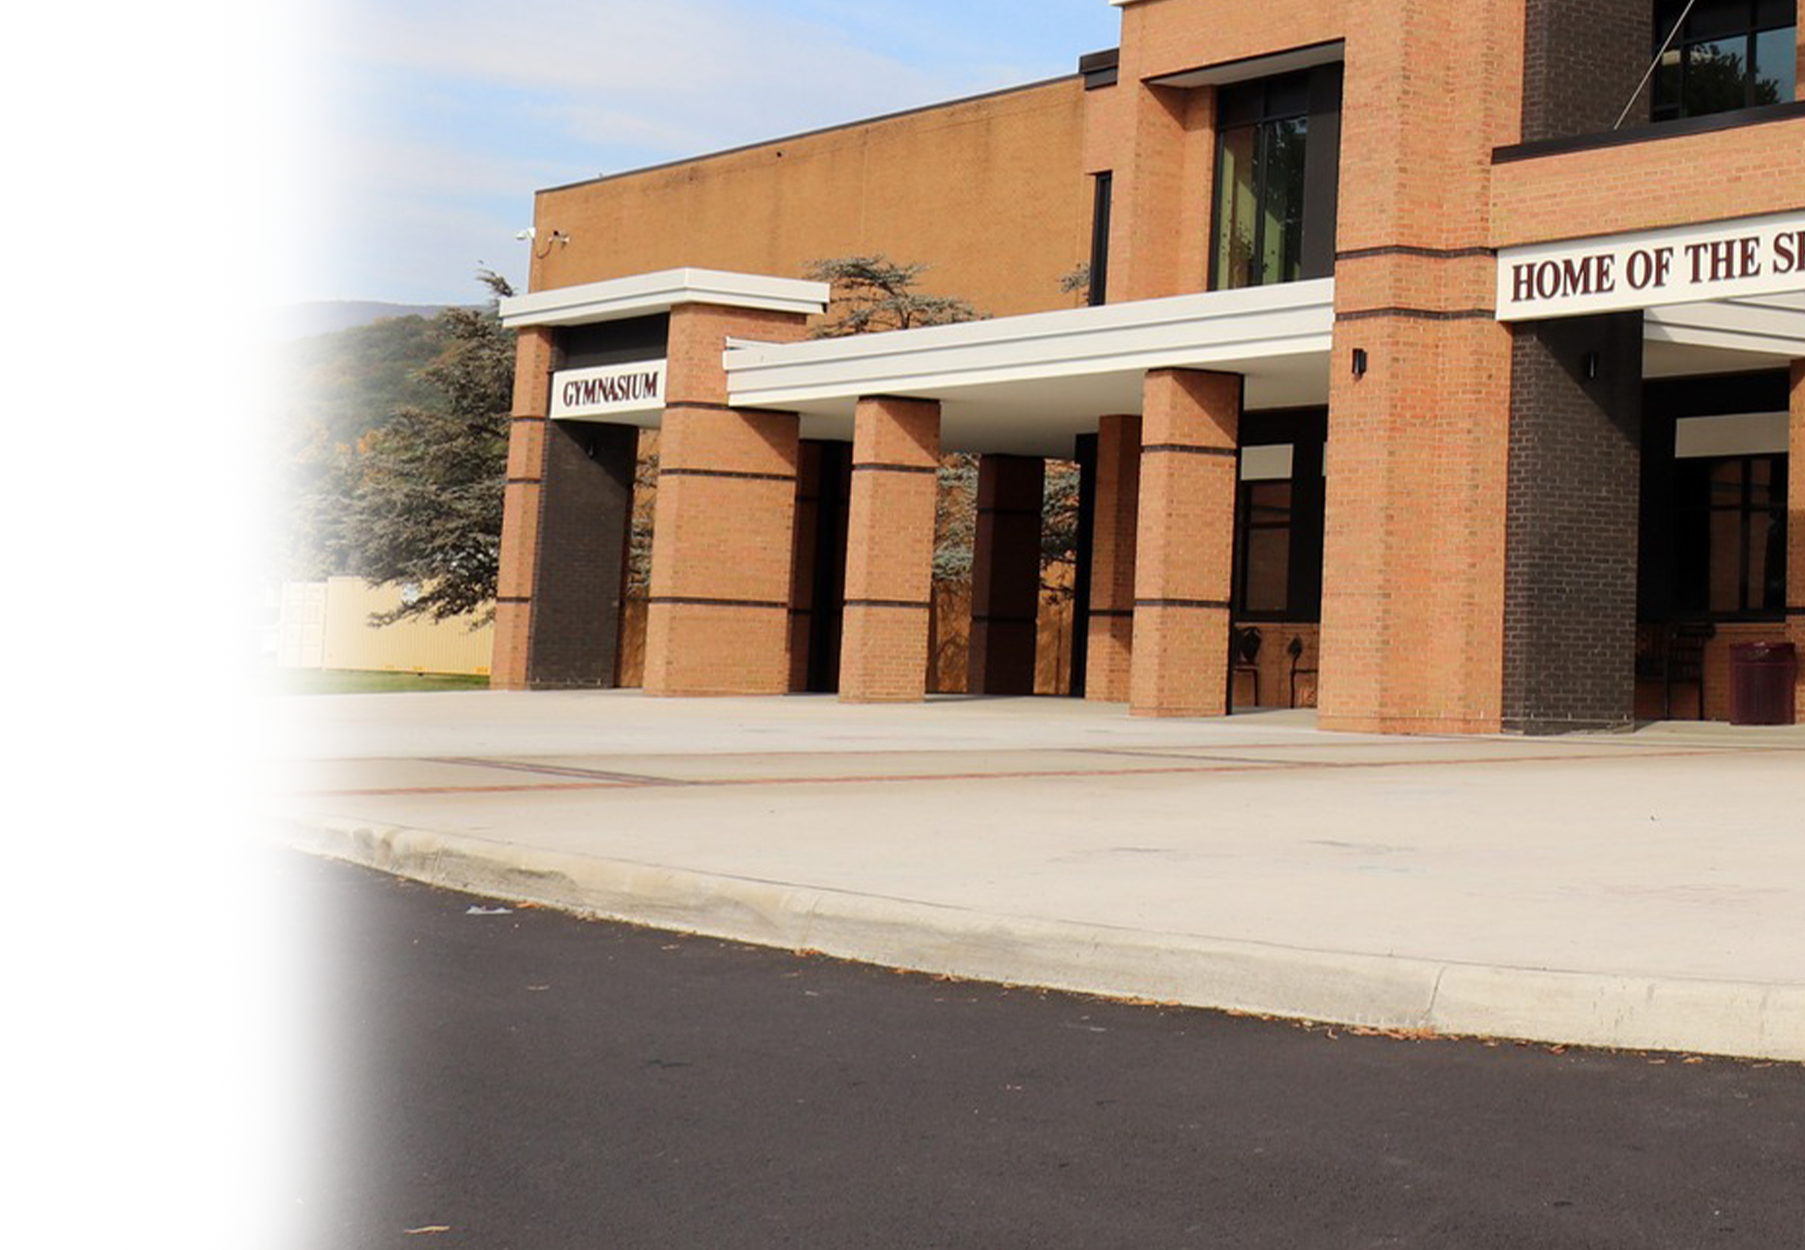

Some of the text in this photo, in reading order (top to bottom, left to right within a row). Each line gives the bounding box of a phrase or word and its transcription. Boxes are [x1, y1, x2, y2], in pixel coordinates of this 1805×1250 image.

[1512, 254, 1615, 301] HOME
[1626, 247, 1674, 290] OF
[1685, 237, 1762, 283] THE
[563, 372, 659, 407] GYMNASIUM
